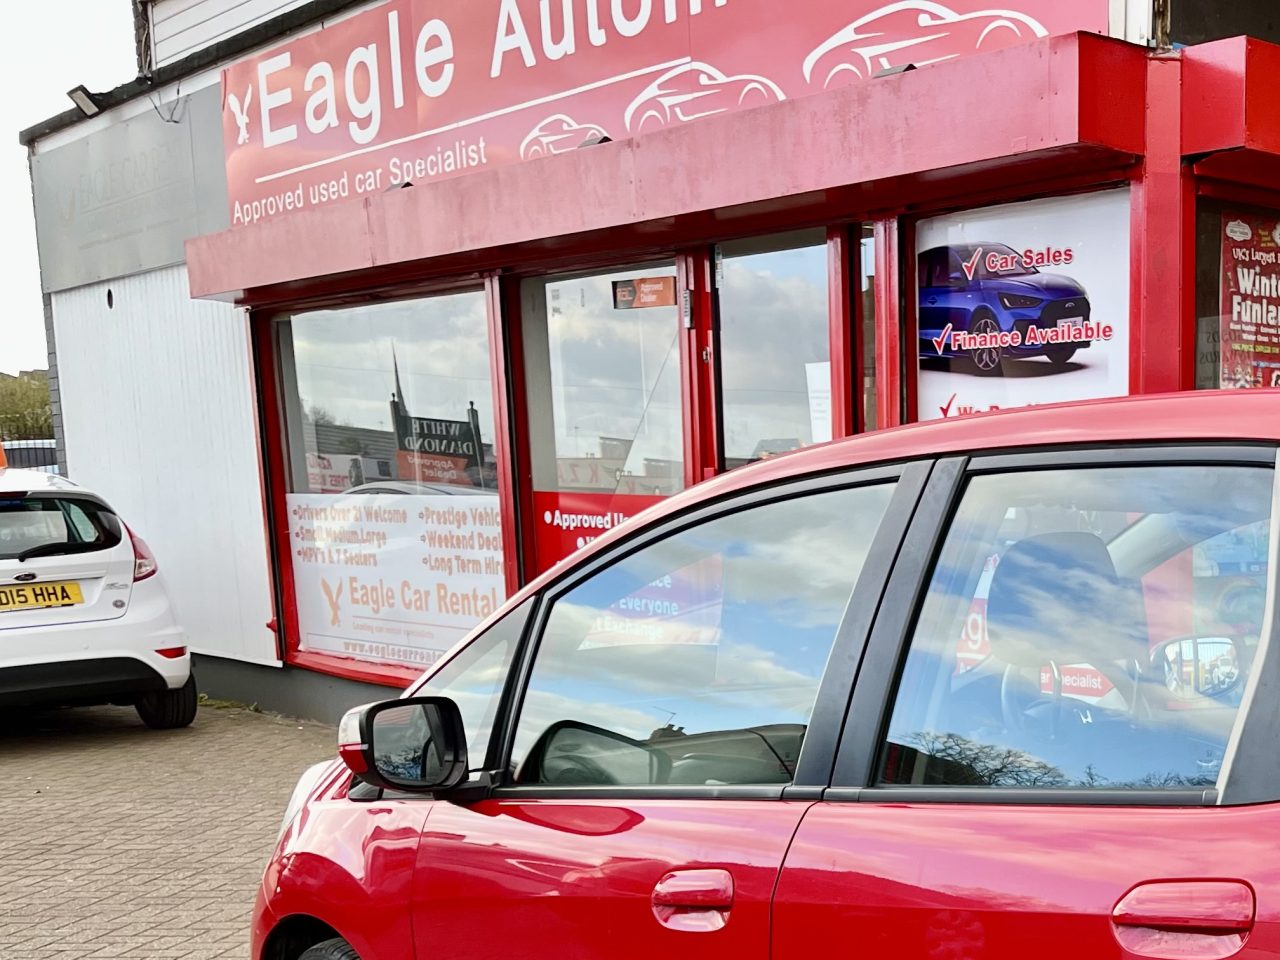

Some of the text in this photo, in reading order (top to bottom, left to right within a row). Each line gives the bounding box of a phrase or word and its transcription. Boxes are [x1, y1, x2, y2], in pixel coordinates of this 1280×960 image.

[257, 10, 455, 144] Eagle
[232, 183, 304, 226] Approved
[310, 171, 349, 205] used
[355, 168, 383, 190] car
[389, 136, 488, 183] Specialist
[985, 245, 1074, 272] Car Sales
[1251, 247, 1276, 265] Largest
[950, 321, 1114, 350] Finance Available
[364, 505, 408, 524] Welcome
[424, 506, 468, 529] Prestige
[553, 509, 612, 531] Approved
[425, 530, 475, 550] Weekend
[428, 553, 453, 577] Long
[454, 554, 482, 575] Term
[32, 585, 72, 603] HHA
[348, 575, 498, 618] Eagle Car Rental
